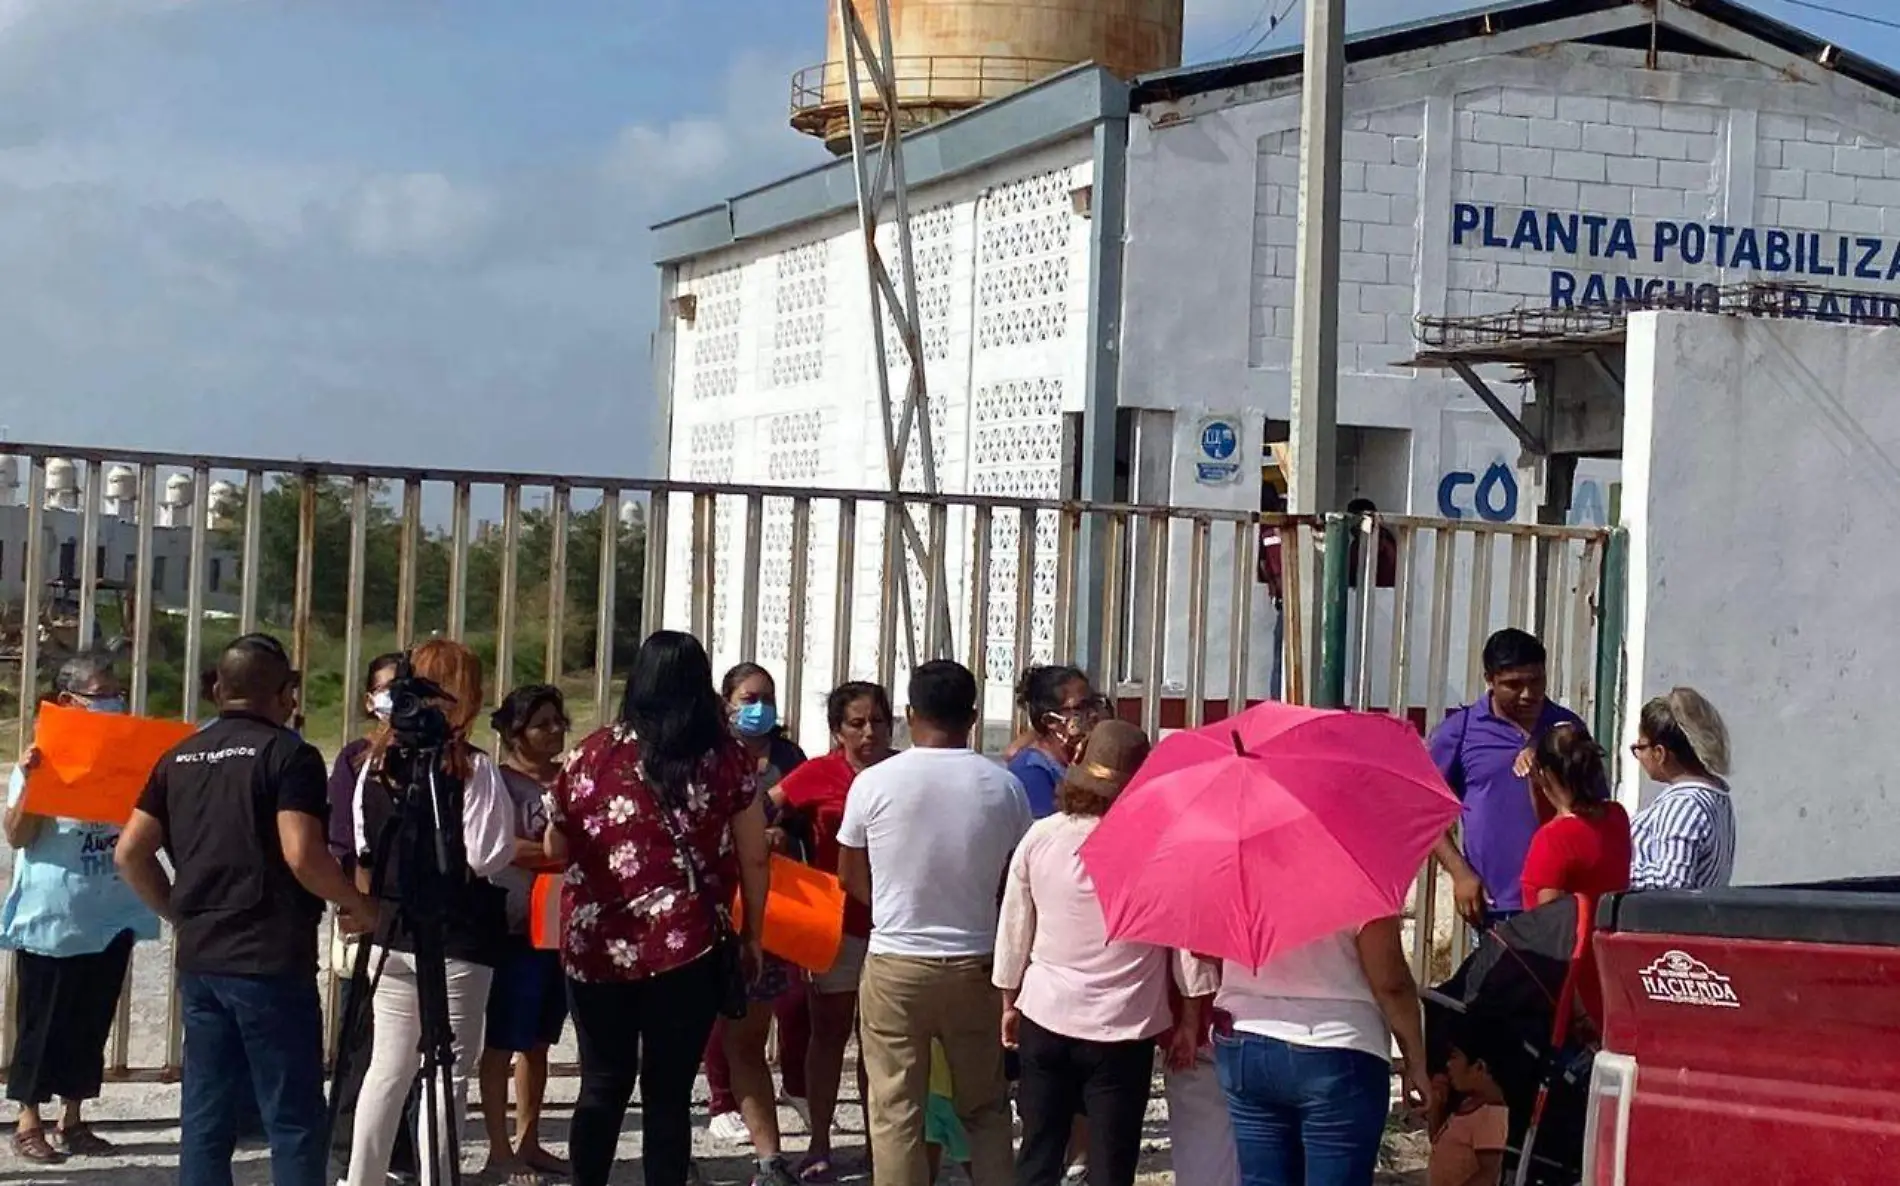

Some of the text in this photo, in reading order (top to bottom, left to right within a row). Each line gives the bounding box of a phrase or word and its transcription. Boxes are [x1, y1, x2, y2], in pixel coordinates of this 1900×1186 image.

[1453, 203, 1637, 260] PLANTA
[1551, 270, 1720, 314] RANCHO
[1641, 976, 1738, 1001] HACIENDA
